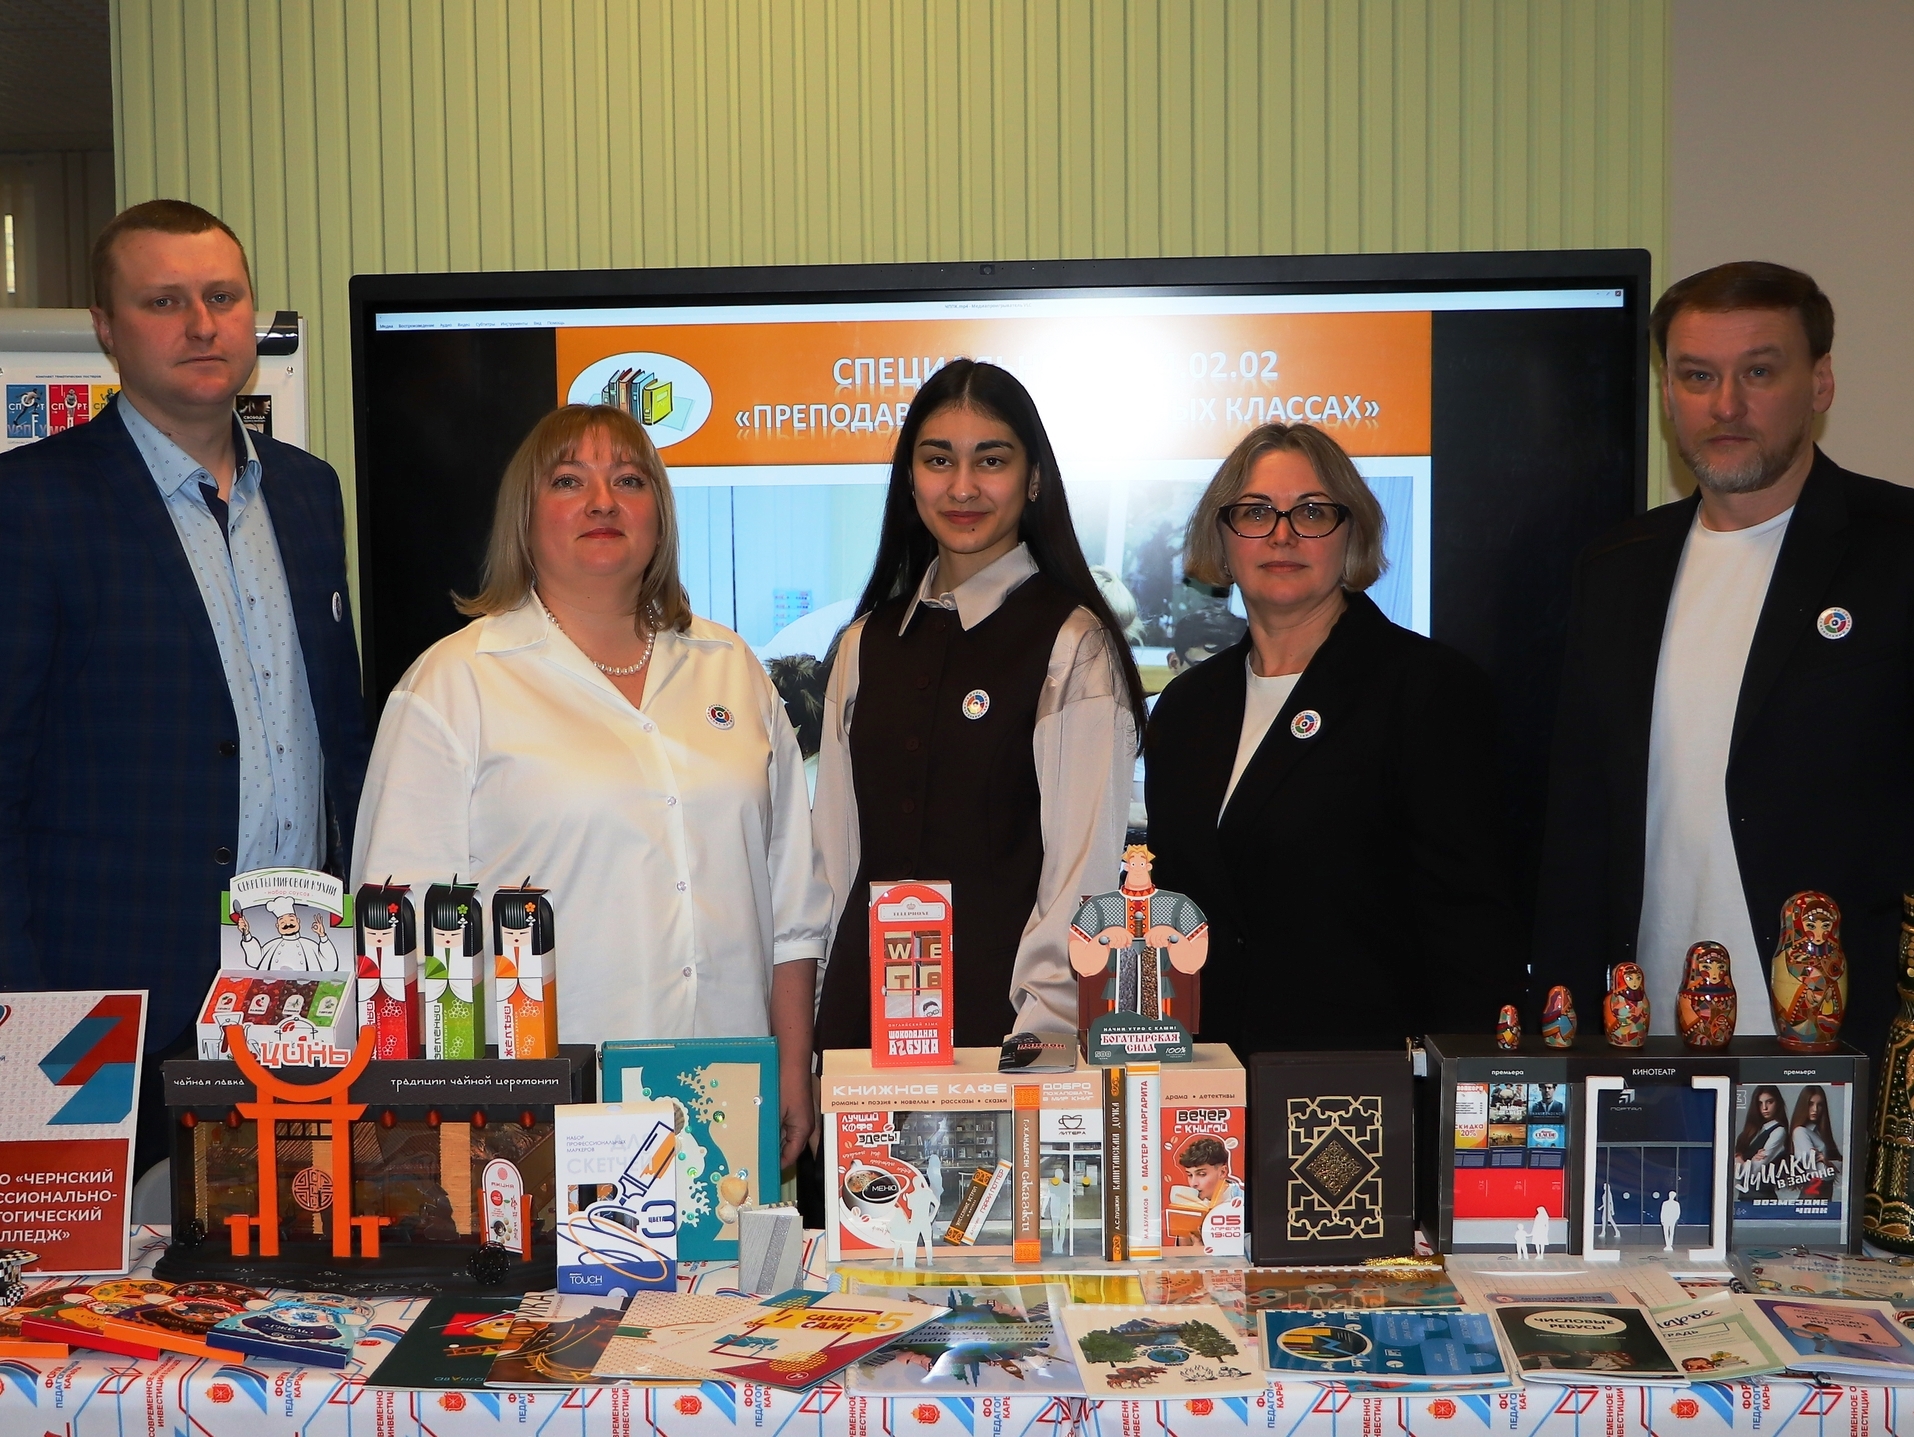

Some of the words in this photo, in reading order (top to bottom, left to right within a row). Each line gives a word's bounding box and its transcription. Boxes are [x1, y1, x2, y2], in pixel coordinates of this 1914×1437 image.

[1225, 394, 1381, 422] КЛАССАХ»
[237, 876, 272, 893] СЕКРЕТЫ
[273, 876, 309, 890] МИРОВОЙ
[310, 879, 337, 897] КУХНИ
[887, 942, 912, 960] W
[894, 974, 910, 988] T
[888, 1029, 938, 1040] ШОКОЛАДНАЯ
[1102, 1033, 1178, 1044] БОГАТЫРСКАЯ
[1126, 1043, 1155, 1053] СИЛА
[1165, 1045, 1187, 1054] 100%
[1491, 1069, 1524, 1077] премьера
[1632, 1068, 1676, 1076] КИНОТЕАТР
[173, 1077, 211, 1086] чайная
[390, 1077, 446, 1092] традиции
[450, 1075, 492, 1086] чайной
[495, 1077, 559, 1092] церемонии
[1042, 1082, 1092, 1091] ДОБРО
[832, 1084, 939, 1096] КНИЖНОЕ
[948, 1083, 1008, 1095] КАФЕ
[1140, 1080, 1148, 1132] МАРГАРИТА
[1112, 1101, 1121, 1129] ДОЧКА
[1140, 1133, 1149, 1142] И
[1141, 1142, 1149, 1178] МАСТЕР
[15, 1168, 114, 1185] «ЧЕРНСКИЙ
[871, 1184, 898, 1192] МЕНЮ
[1804, 1177, 1823, 1195] 2
[0, 1206, 102, 1223] ОГИЧЕСКИЙ
[1210, 1215, 1242, 1226] 05
[569, 1275, 603, 1285] TOUCH
[805, 1313, 869, 1324] СДЕЛАЙ
[1533, 1317, 1615, 1325] ЧИСЛОВЫЕ
[800, 1321, 855, 1331] САМ!
